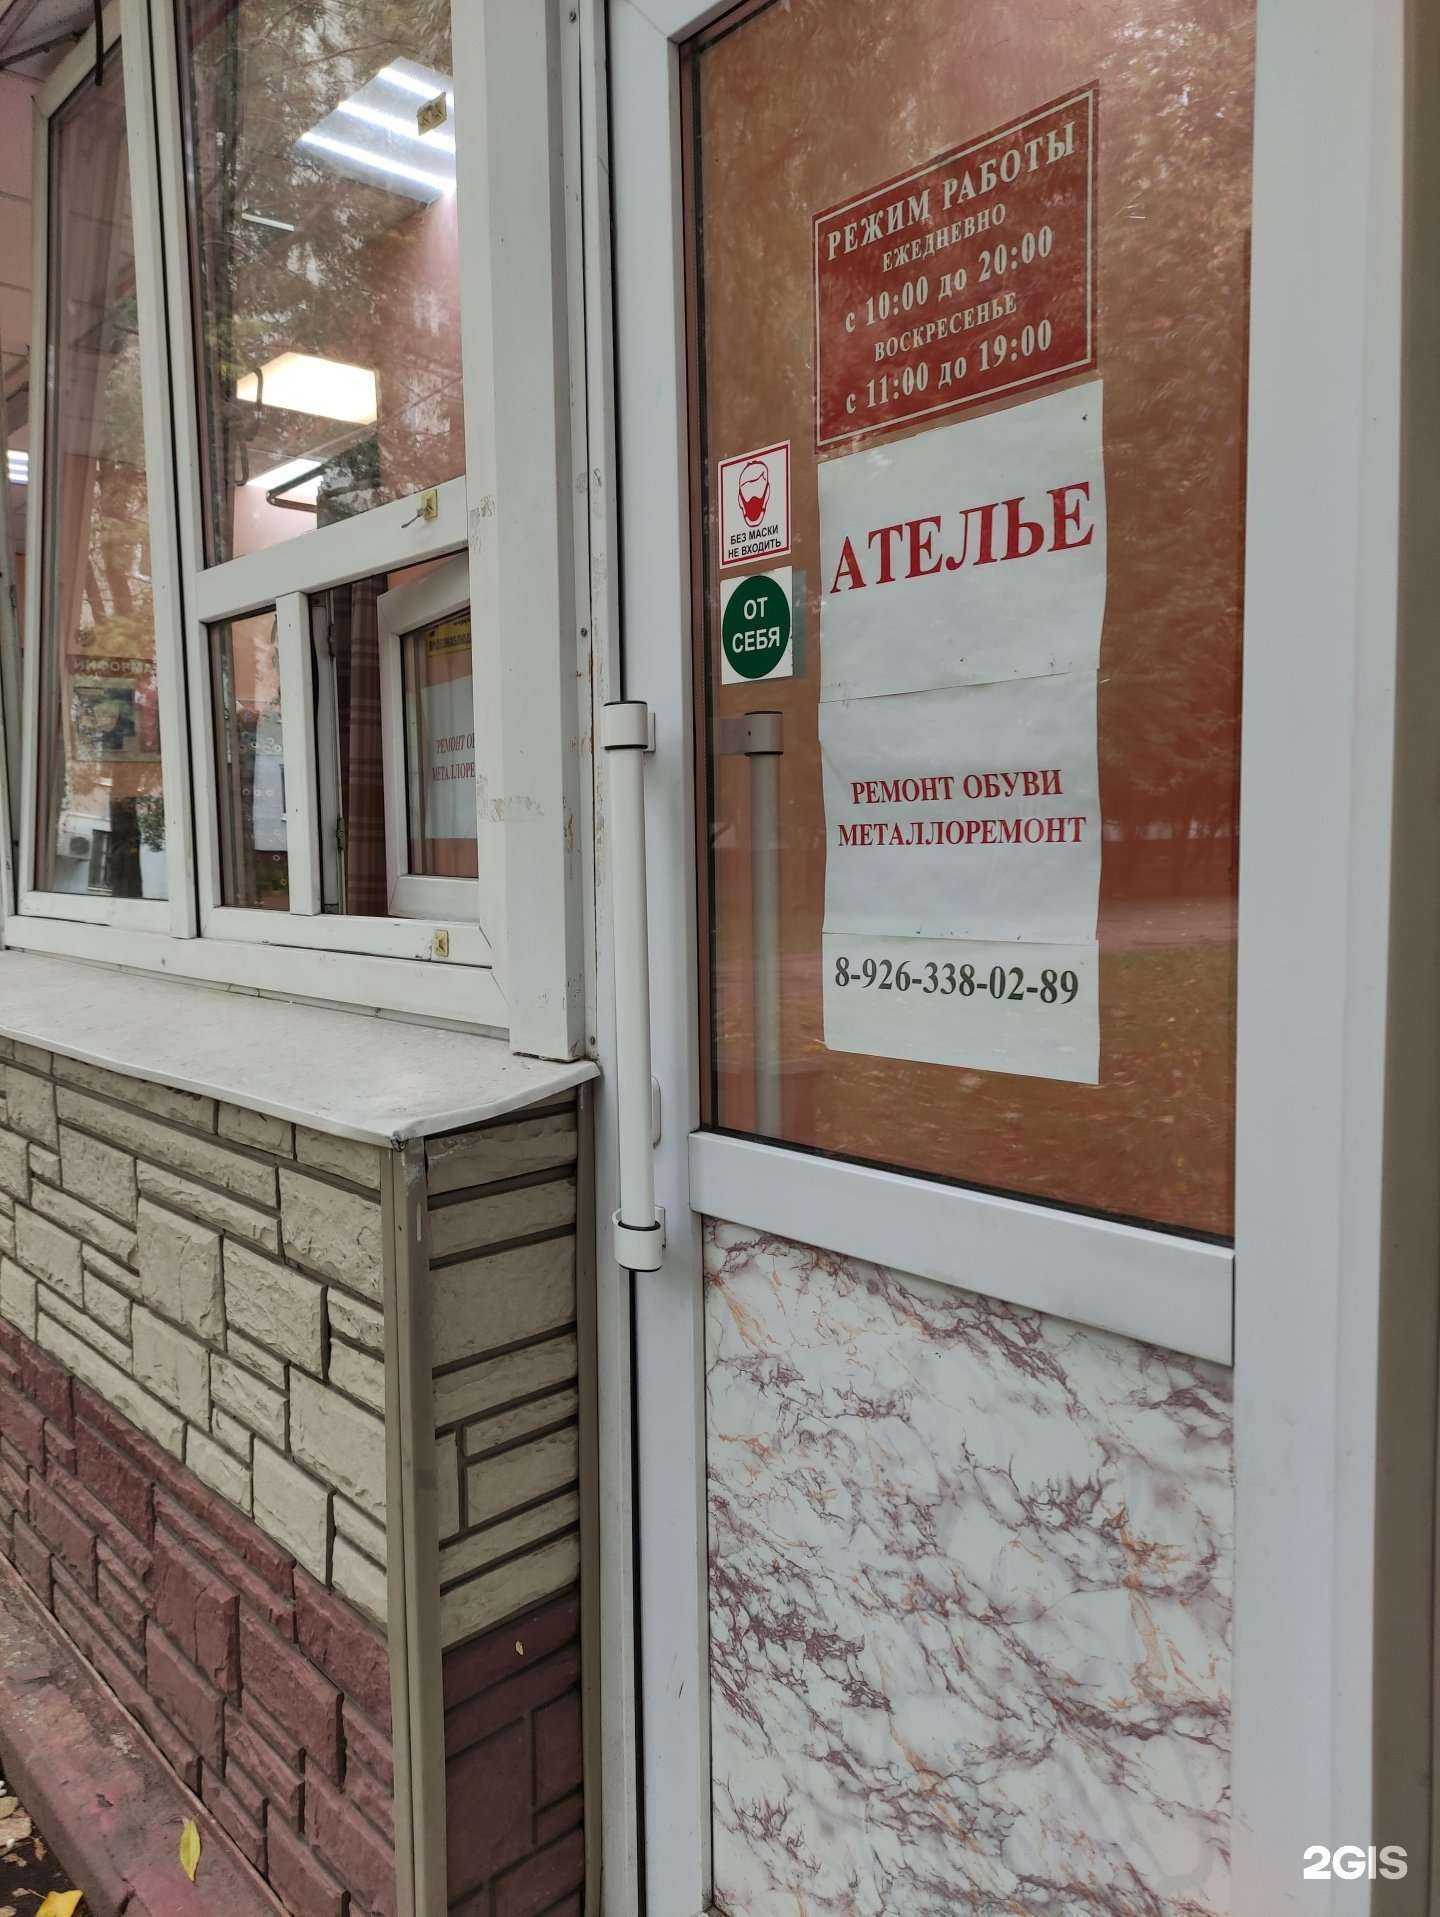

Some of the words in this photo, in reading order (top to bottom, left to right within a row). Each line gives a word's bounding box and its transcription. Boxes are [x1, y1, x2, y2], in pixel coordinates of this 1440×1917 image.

[827, 190, 930, 261] РЕЖИМ
[943, 121, 1077, 210] РАБОТЫ
[882, 203, 1006, 273] ЕЖЕДНЕВНО
[845, 310, 856, 333] с
[865, 276, 929, 326] 10:00
[938, 268, 967, 301] до
[978, 225, 1053, 283] 20:00
[874, 292, 1017, 362] ВОСКРЕСЕНЬЕ
[846, 391, 857, 415] с
[866, 362, 929, 409] 11:00
[938, 356, 967, 389] до
[978, 319, 1053, 373] 19:00
[728, 547, 740, 559] НЕ
[741, 538, 782, 556] ВХОДИТЬ
[730, 532, 747, 545] БЕЗ
[749, 524, 779, 540] МАСКИ
[829, 481, 1095, 594] АТЕЛЬЕ
[743, 596, 768, 620] ОТ
[732, 626, 780, 654] СЕБЯ
[850, 776, 954, 804] РЕМОНТ
[963, 769, 1064, 800] ОБУВИ
[837, 816, 1086, 847] МЕТАЛЛОРЕМОНТ
[834, 956, 1079, 1005] 8-926-338-02-89
